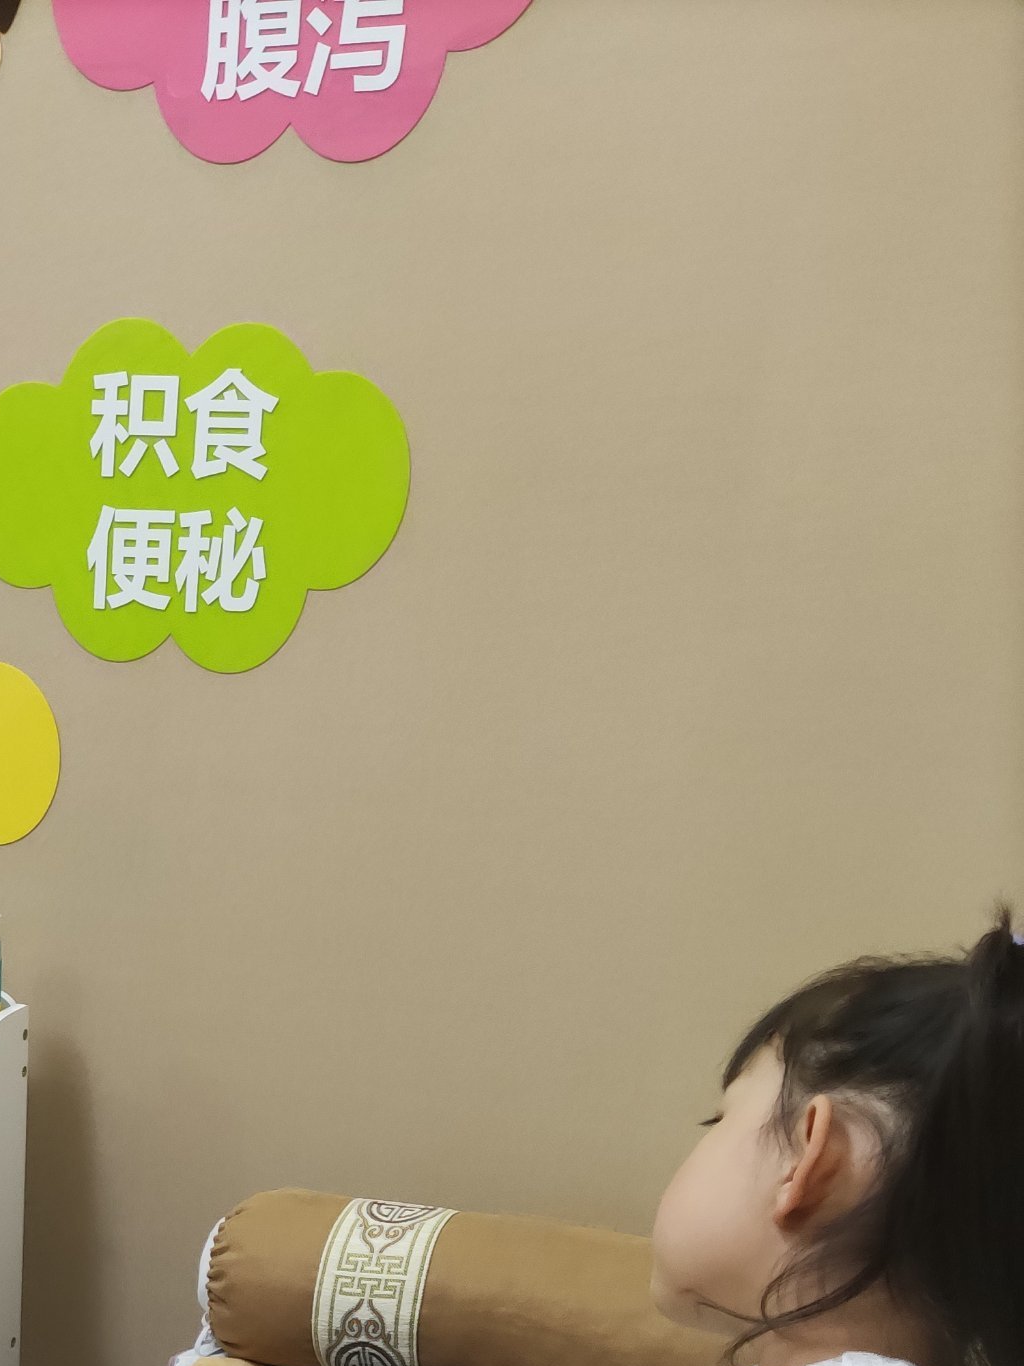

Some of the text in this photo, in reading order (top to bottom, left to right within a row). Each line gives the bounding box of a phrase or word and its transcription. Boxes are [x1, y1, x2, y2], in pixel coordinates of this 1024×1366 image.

[200, 0, 407, 102] 腹泻
[89, 368, 280, 481] 积食
[86, 504, 267, 613] 便秘
